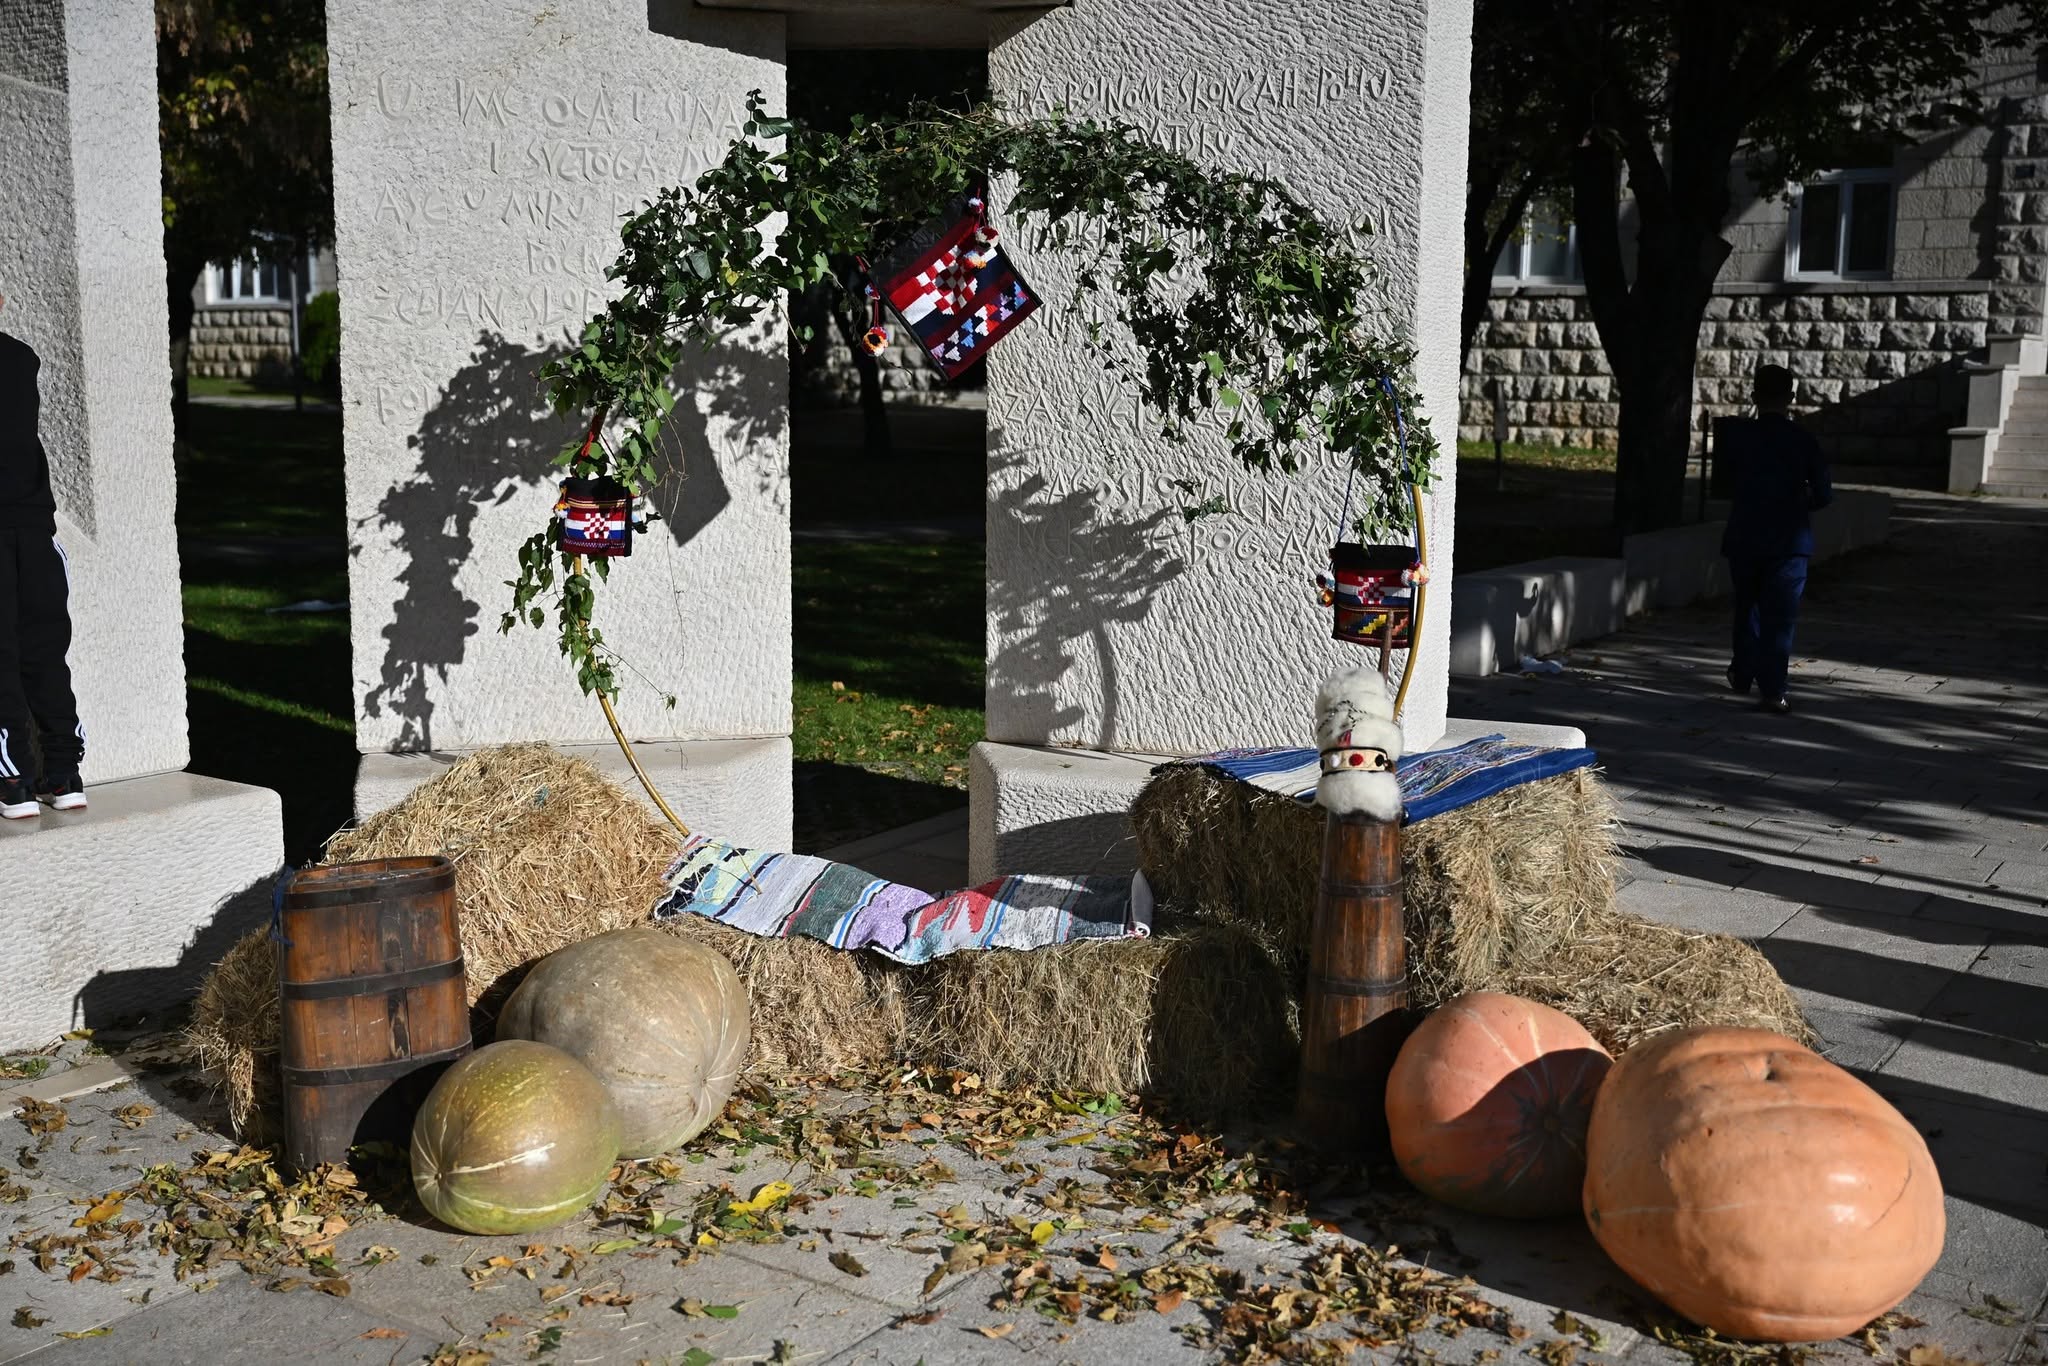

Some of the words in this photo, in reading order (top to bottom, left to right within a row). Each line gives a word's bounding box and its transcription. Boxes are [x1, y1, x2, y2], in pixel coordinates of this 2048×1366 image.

[376, 71, 418, 122] U
[1004, 387, 1056, 427] ZA
[1190, 523, 1262, 566] BOG
